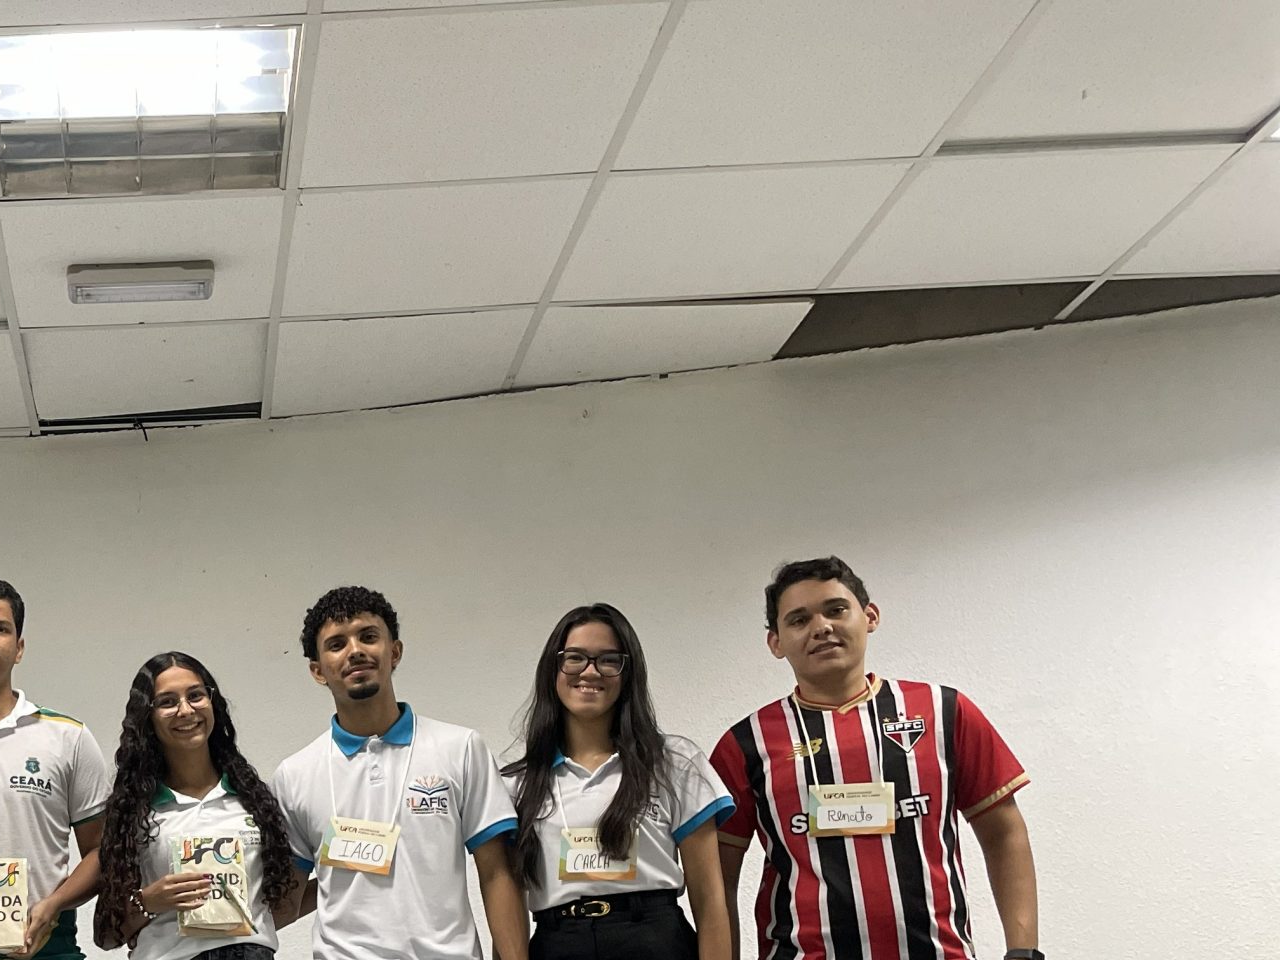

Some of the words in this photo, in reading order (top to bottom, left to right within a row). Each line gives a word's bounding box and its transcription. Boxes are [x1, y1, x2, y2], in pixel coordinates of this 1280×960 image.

[886, 721, 923, 732] SPFC
[10, 775, 52, 791] CEARÁ
[338, 840, 384, 862] IAGO
[573, 853, 610, 870] CARLA
